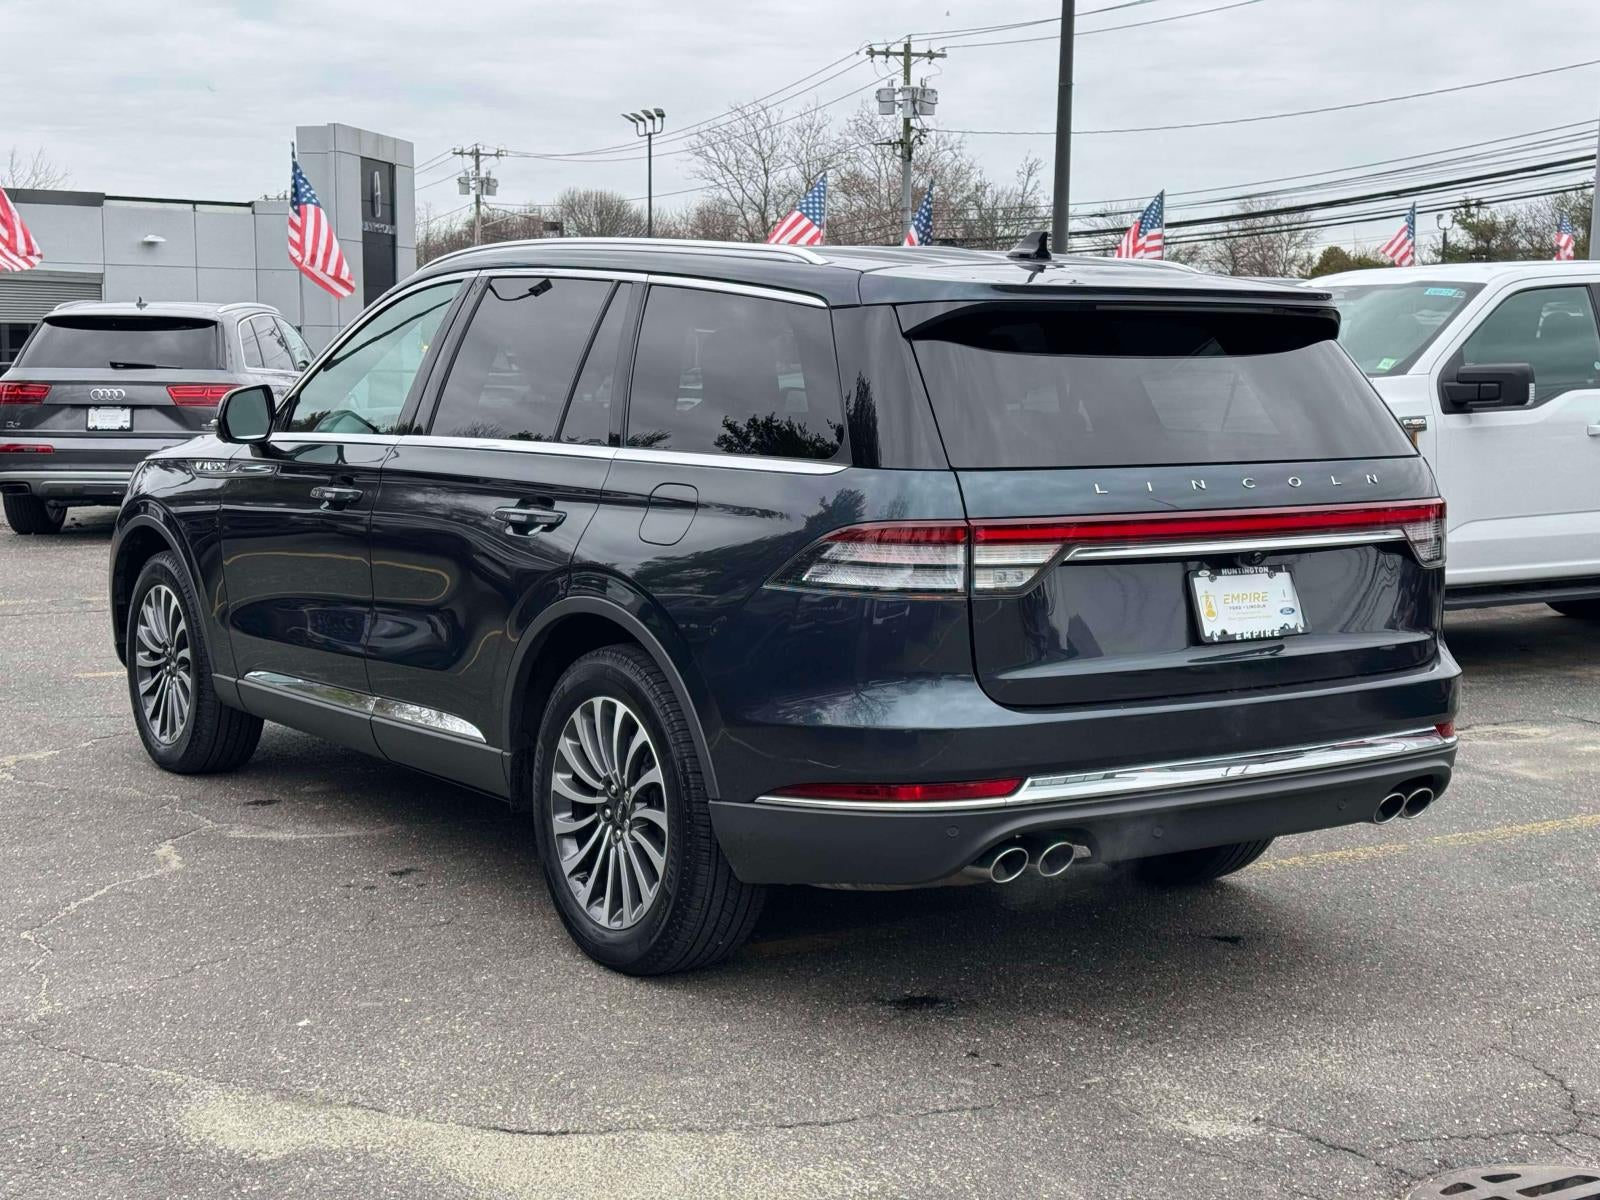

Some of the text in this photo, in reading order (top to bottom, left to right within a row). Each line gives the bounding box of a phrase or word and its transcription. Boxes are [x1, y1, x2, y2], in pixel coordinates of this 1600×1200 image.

[1094, 473, 1379, 495] LINCOLN
[1221, 566, 1269, 576] HUNTINGTON
[1223, 591, 1269, 605] EMPIRE
[1235, 629, 1281, 641] EMPIRE
